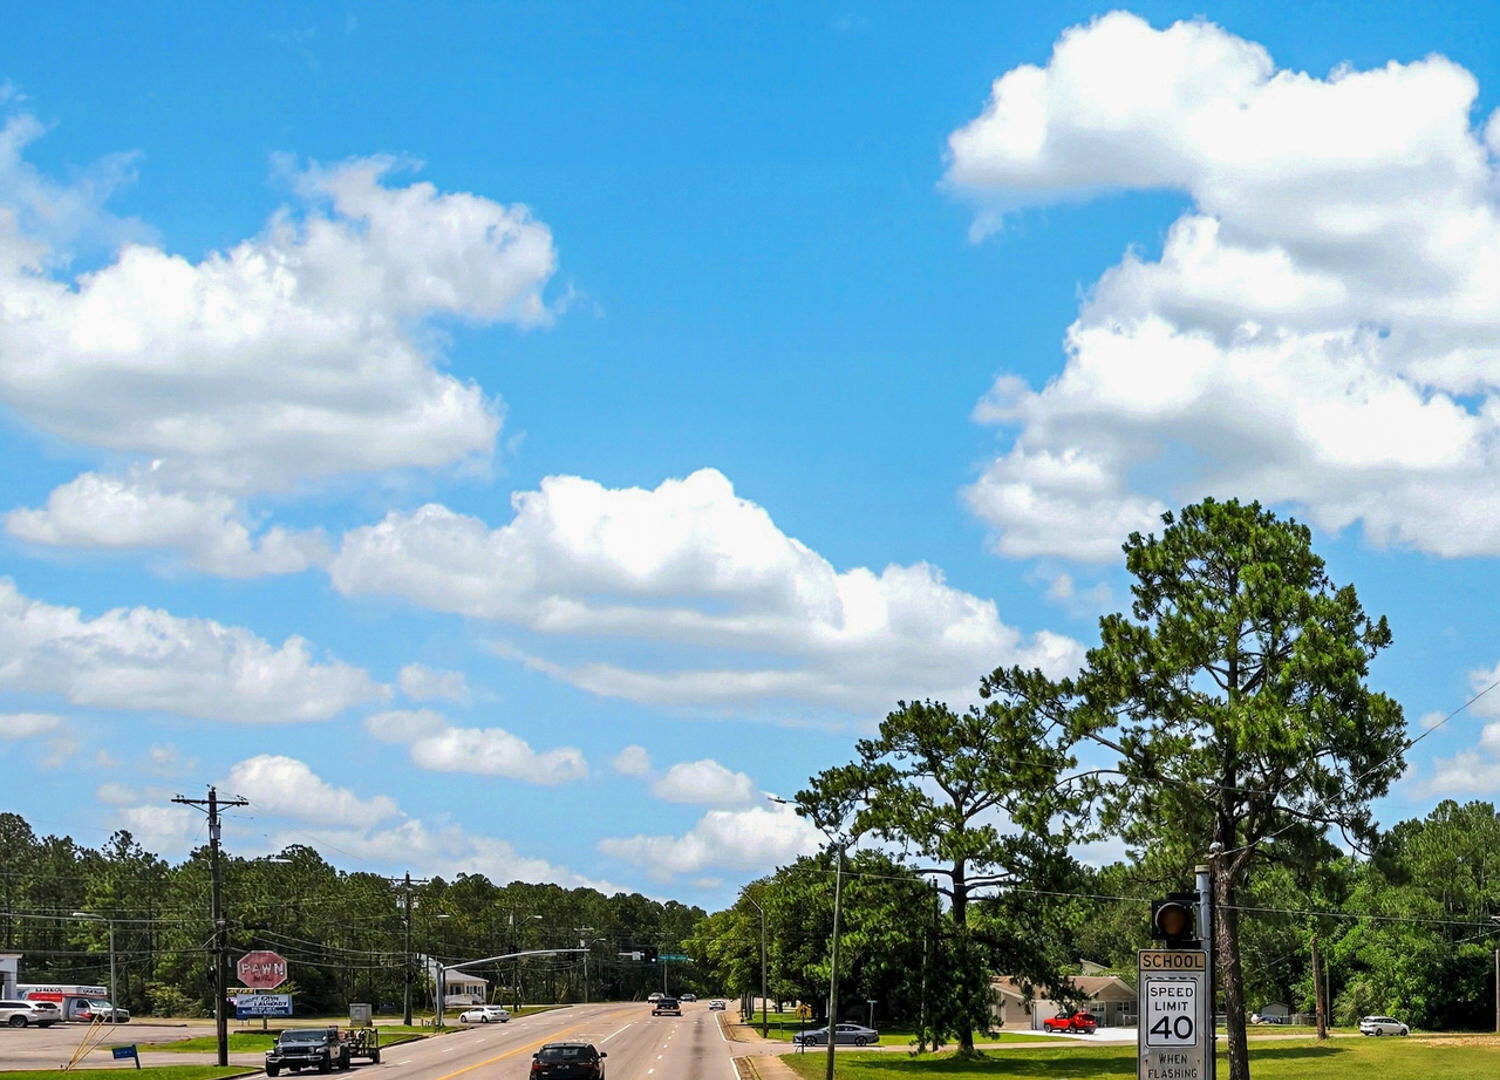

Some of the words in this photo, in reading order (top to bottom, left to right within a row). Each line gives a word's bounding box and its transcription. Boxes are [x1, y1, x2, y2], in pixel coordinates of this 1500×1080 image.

[1143, 954, 1203, 968] SCHOOL
[1150, 987, 1194, 997] SPEED
[1155, 1001, 1188, 1011] LIMIT
[1150, 1015, 1193, 1039] 40
[1159, 1054, 1187, 1064] WHEN
[1148, 1068, 1197, 1079] FLASHING
